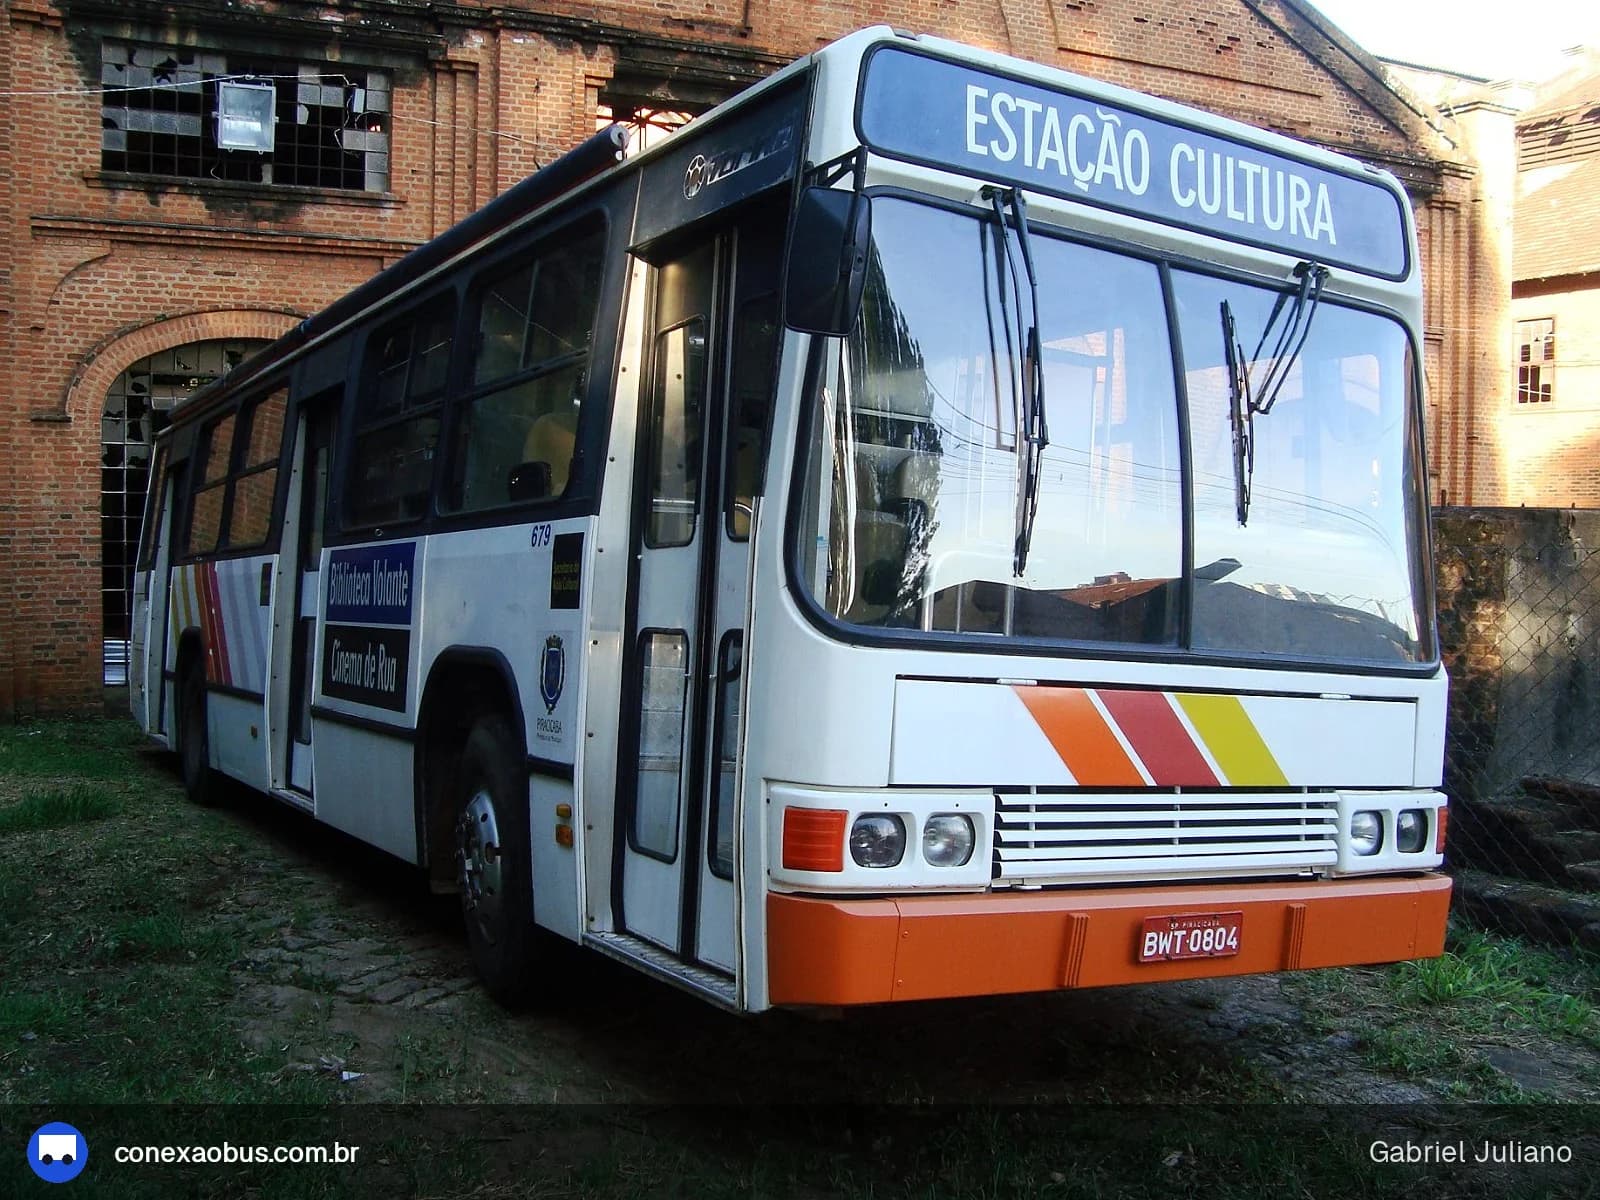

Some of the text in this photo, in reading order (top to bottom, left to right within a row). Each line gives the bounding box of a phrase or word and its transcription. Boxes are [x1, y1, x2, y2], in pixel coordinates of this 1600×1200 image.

[966, 83, 1337, 246] ESTAÇÃO CULTURA
[531, 524, 552, 547] 679
[329, 558, 409, 607] Biblioteca Volante
[331, 638, 397, 693] Cinema de Rua
